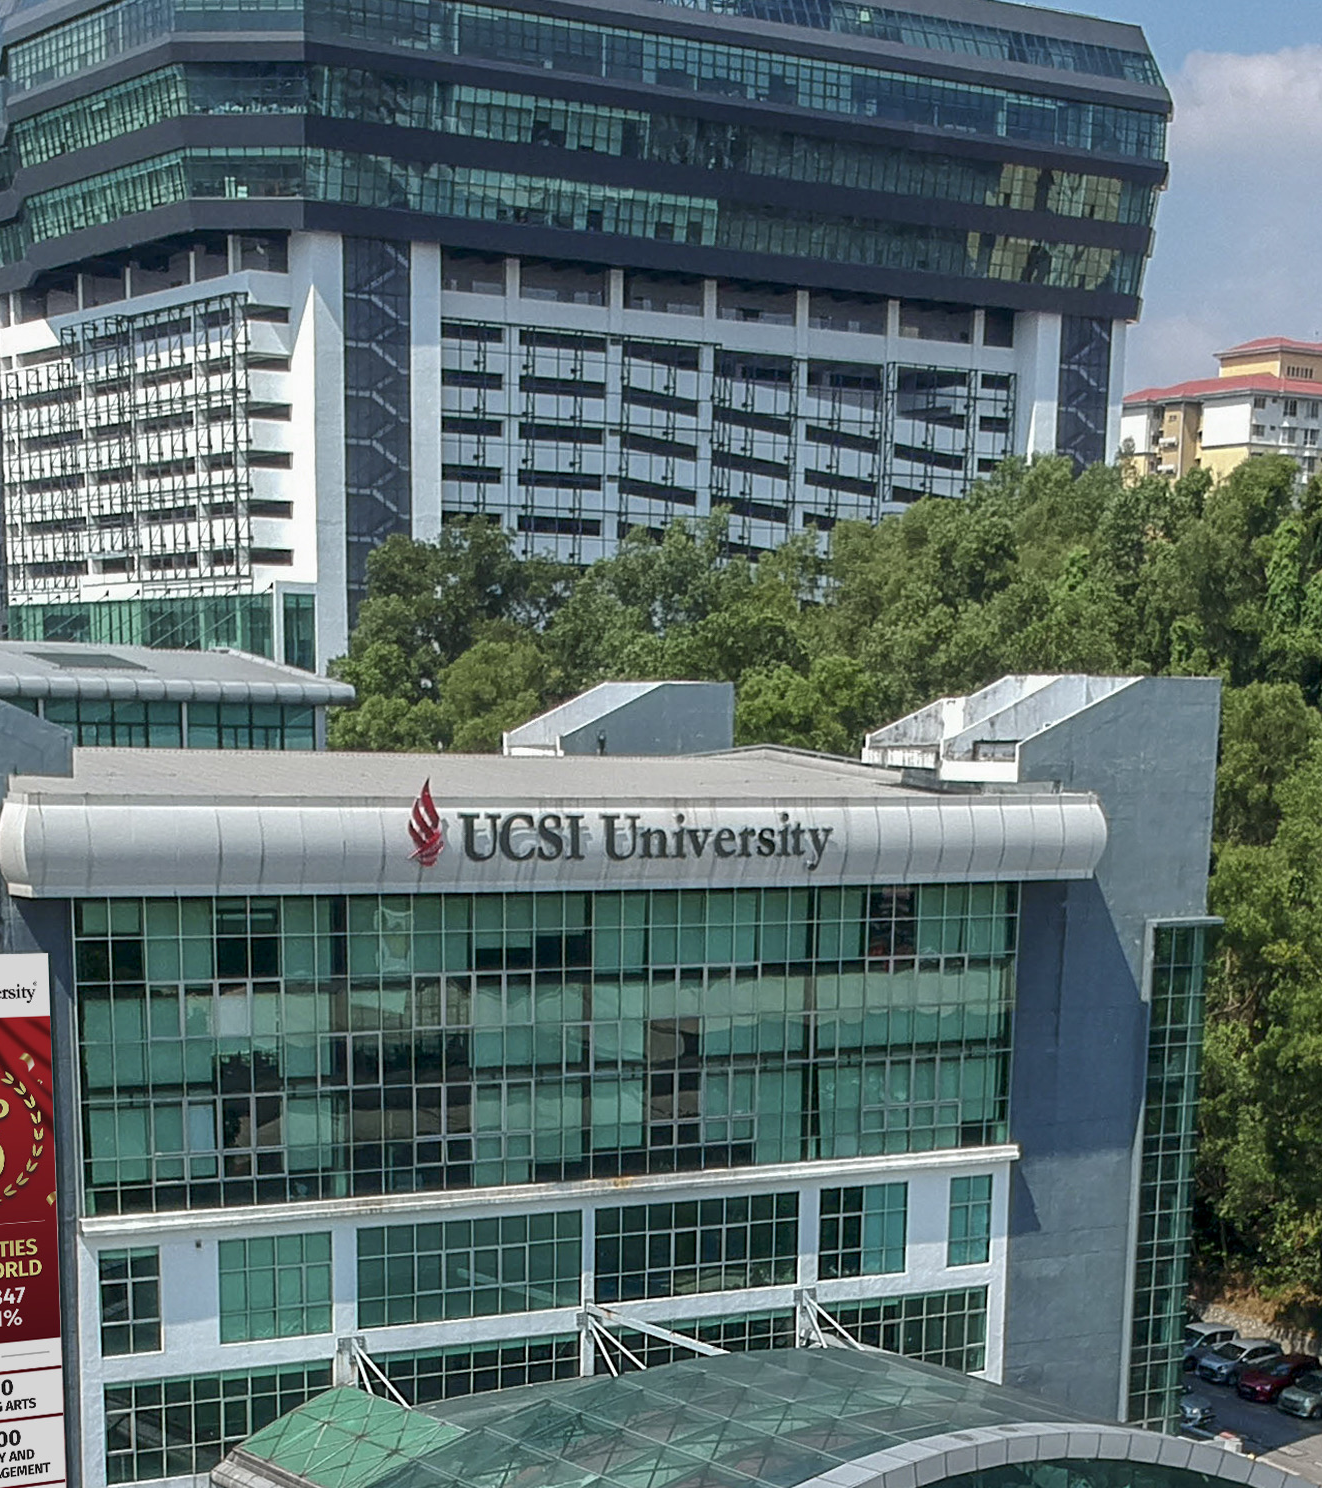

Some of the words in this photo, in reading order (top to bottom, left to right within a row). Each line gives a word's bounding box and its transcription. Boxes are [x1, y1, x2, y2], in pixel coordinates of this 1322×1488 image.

[458, 812, 584, 862] UCSI
[599, 811, 834, 871] University
[5, 1397, 37, 1412] ARTS
[8, 1449, 35, 1463] AND
